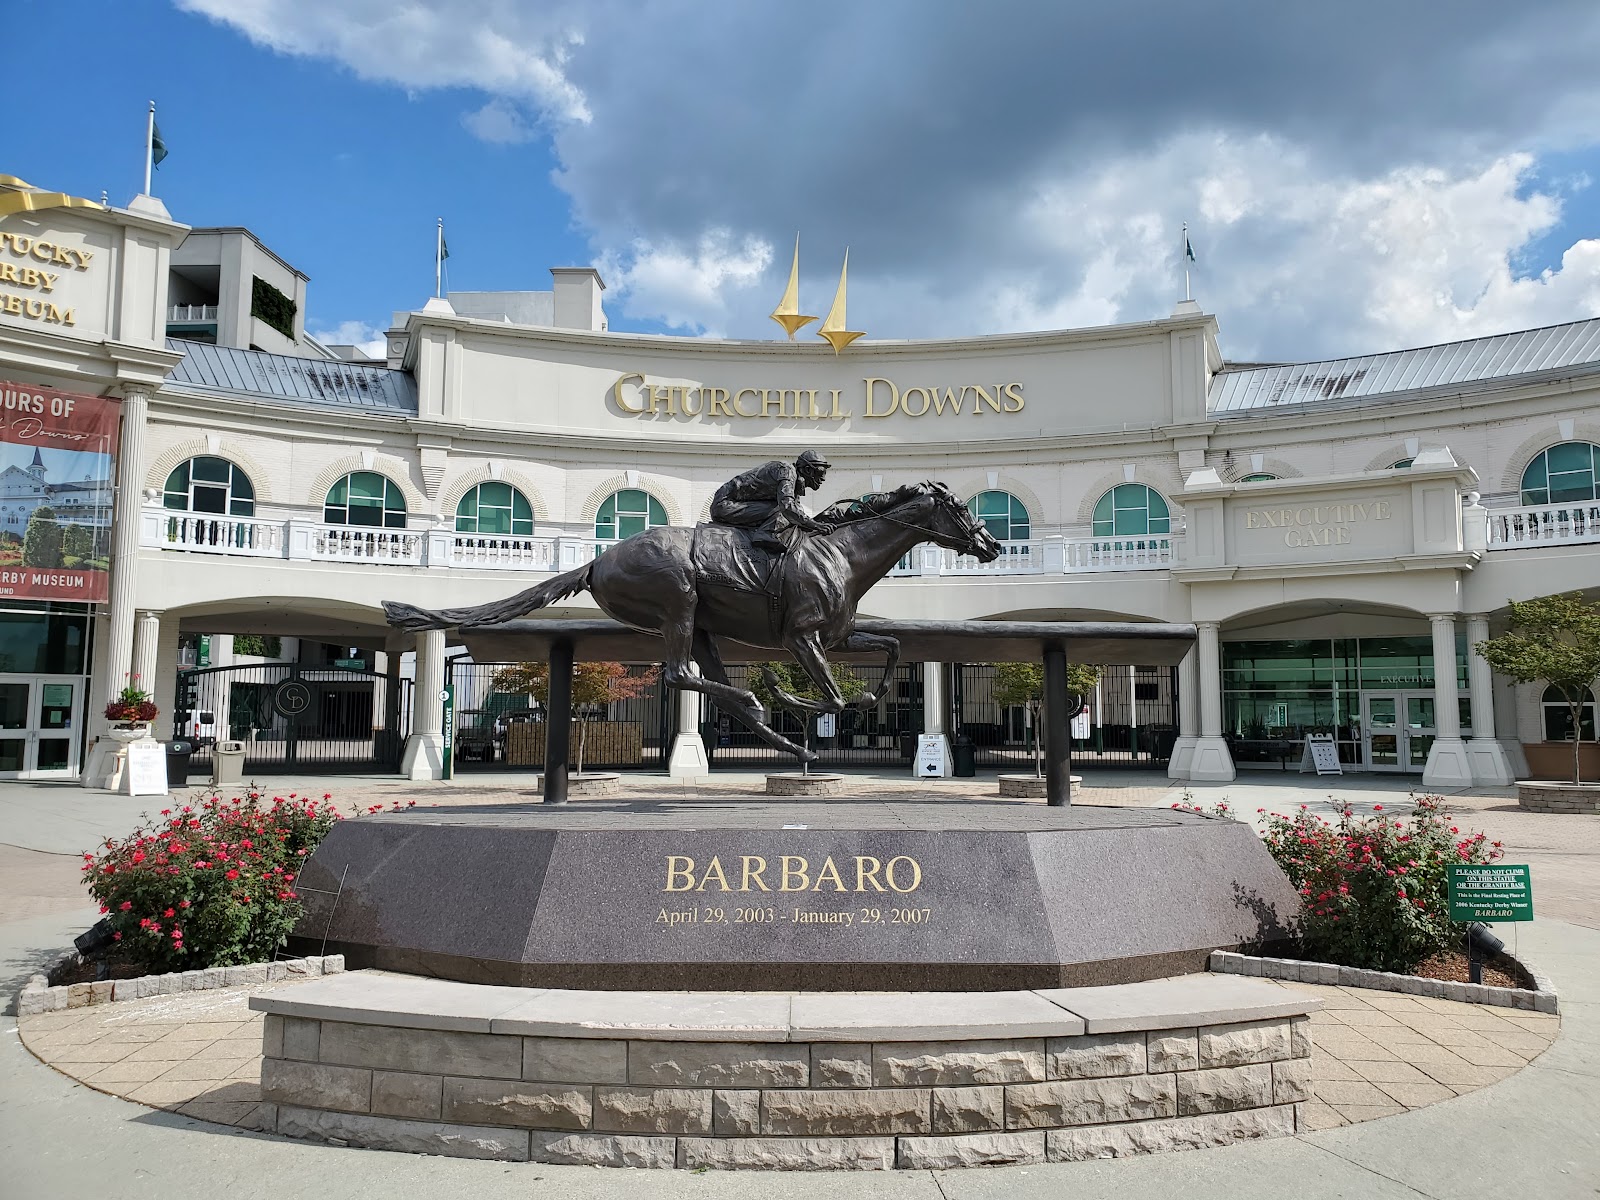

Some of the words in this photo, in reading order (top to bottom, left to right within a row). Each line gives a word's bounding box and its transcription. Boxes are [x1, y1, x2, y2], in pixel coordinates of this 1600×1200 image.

[0, 389, 45, 414] URS
[51, 397, 75, 418] OF
[614, 373, 851, 418] CHURCHILL
[863, 377, 1025, 418] DOWNS
[1246, 501, 1391, 529] EXECUTIVE
[1284, 527, 1351, 548] GATE
[0, 571, 27, 584] RBY
[32, 574, 84, 588] MUSEUM
[1381, 675, 1432, 684] EXECUTIVE
[662, 855, 922, 893] BARBARO
[655, 908, 698, 926] April
[703, 908, 729, 925] 29,
[734, 908, 774, 923] 2003
[792, 908, 855, 927] January
[860, 908, 886, 925] 29,
[891, 908, 931, 923] 2007
